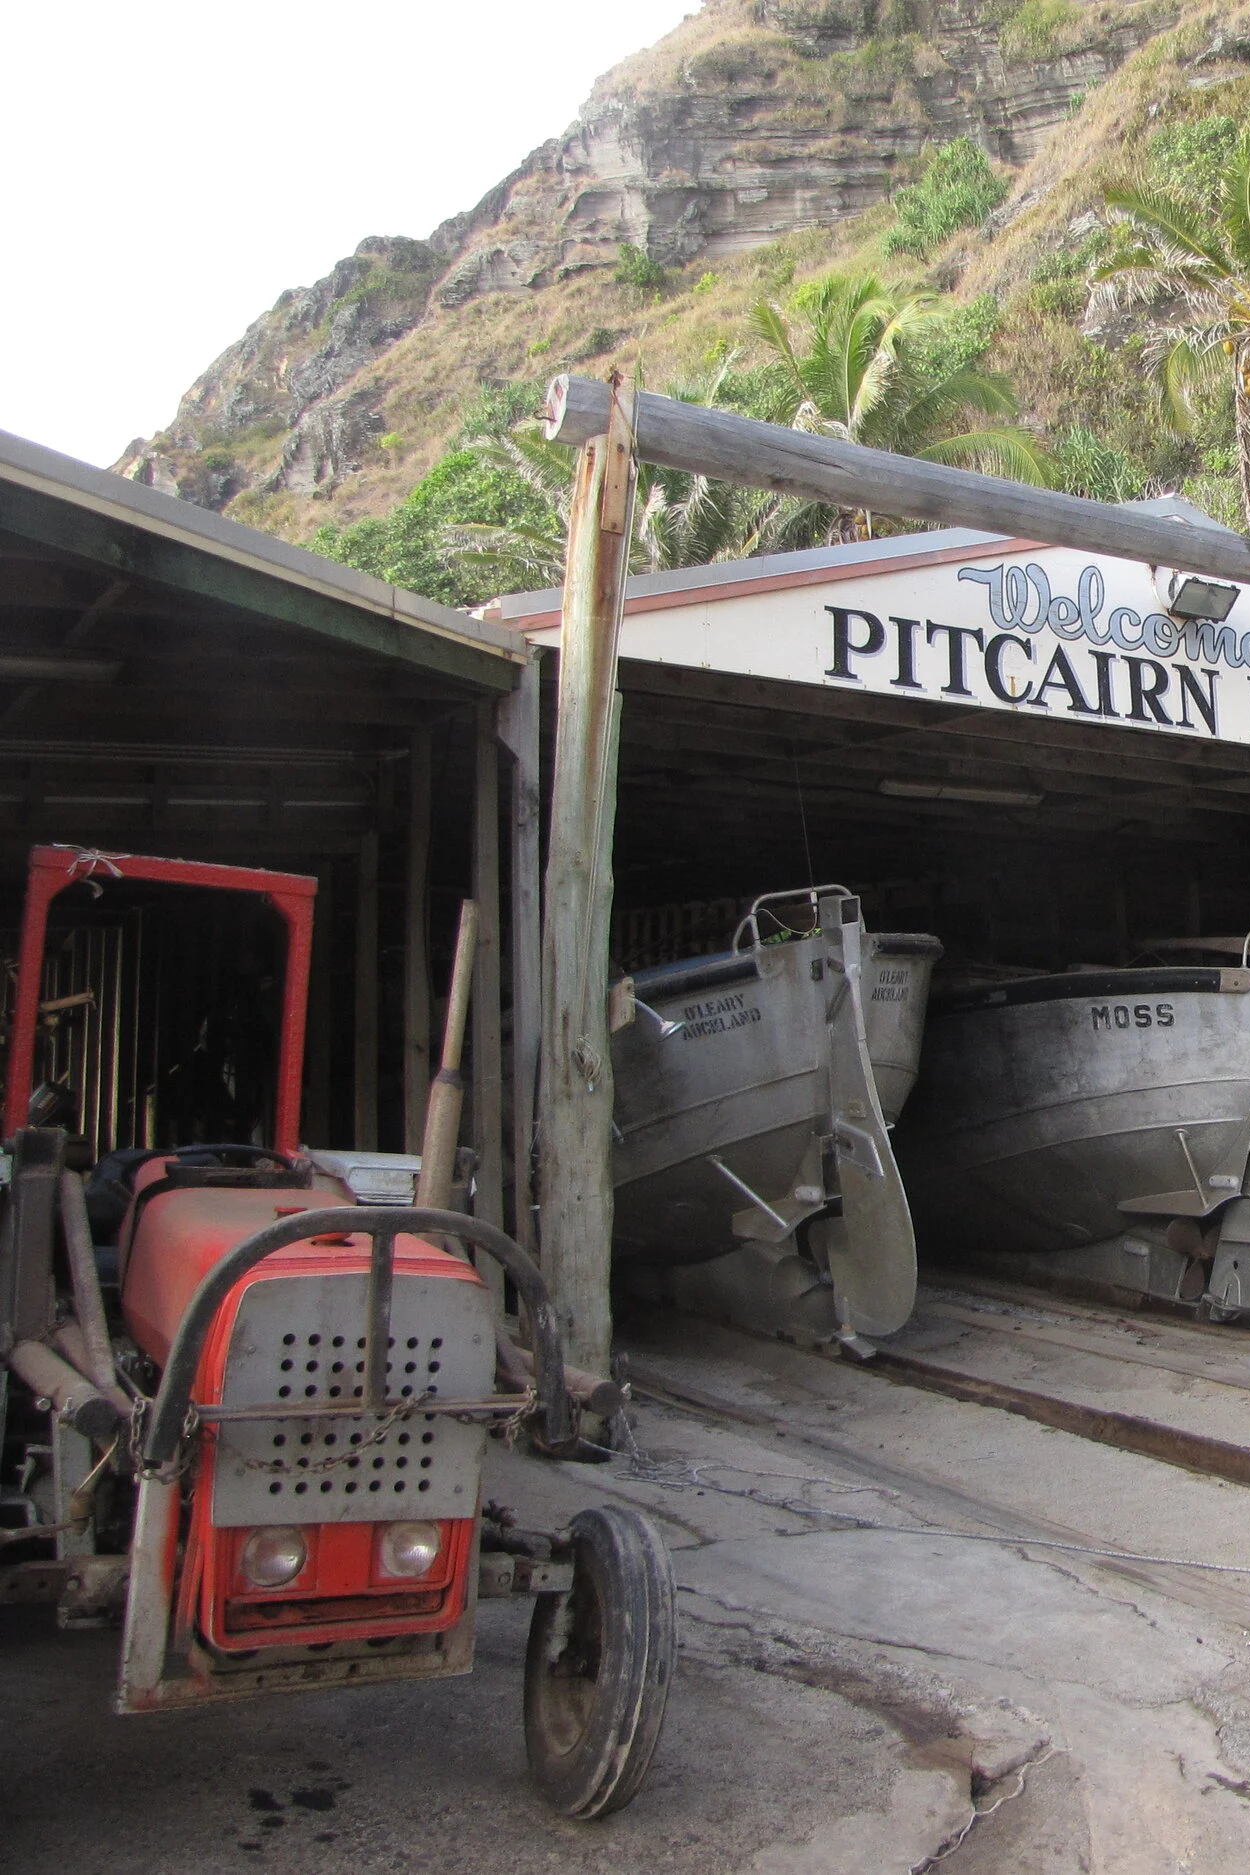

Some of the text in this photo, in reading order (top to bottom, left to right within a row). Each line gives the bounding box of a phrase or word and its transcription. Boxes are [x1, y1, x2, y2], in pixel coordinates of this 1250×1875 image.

[824, 605, 1222, 736] PITCAIRN
[683, 993, 744, 1021] O'LEARY
[1091, 1003, 1175, 1030] MOSS
[681, 1008, 762, 1041] AUCKLAND
